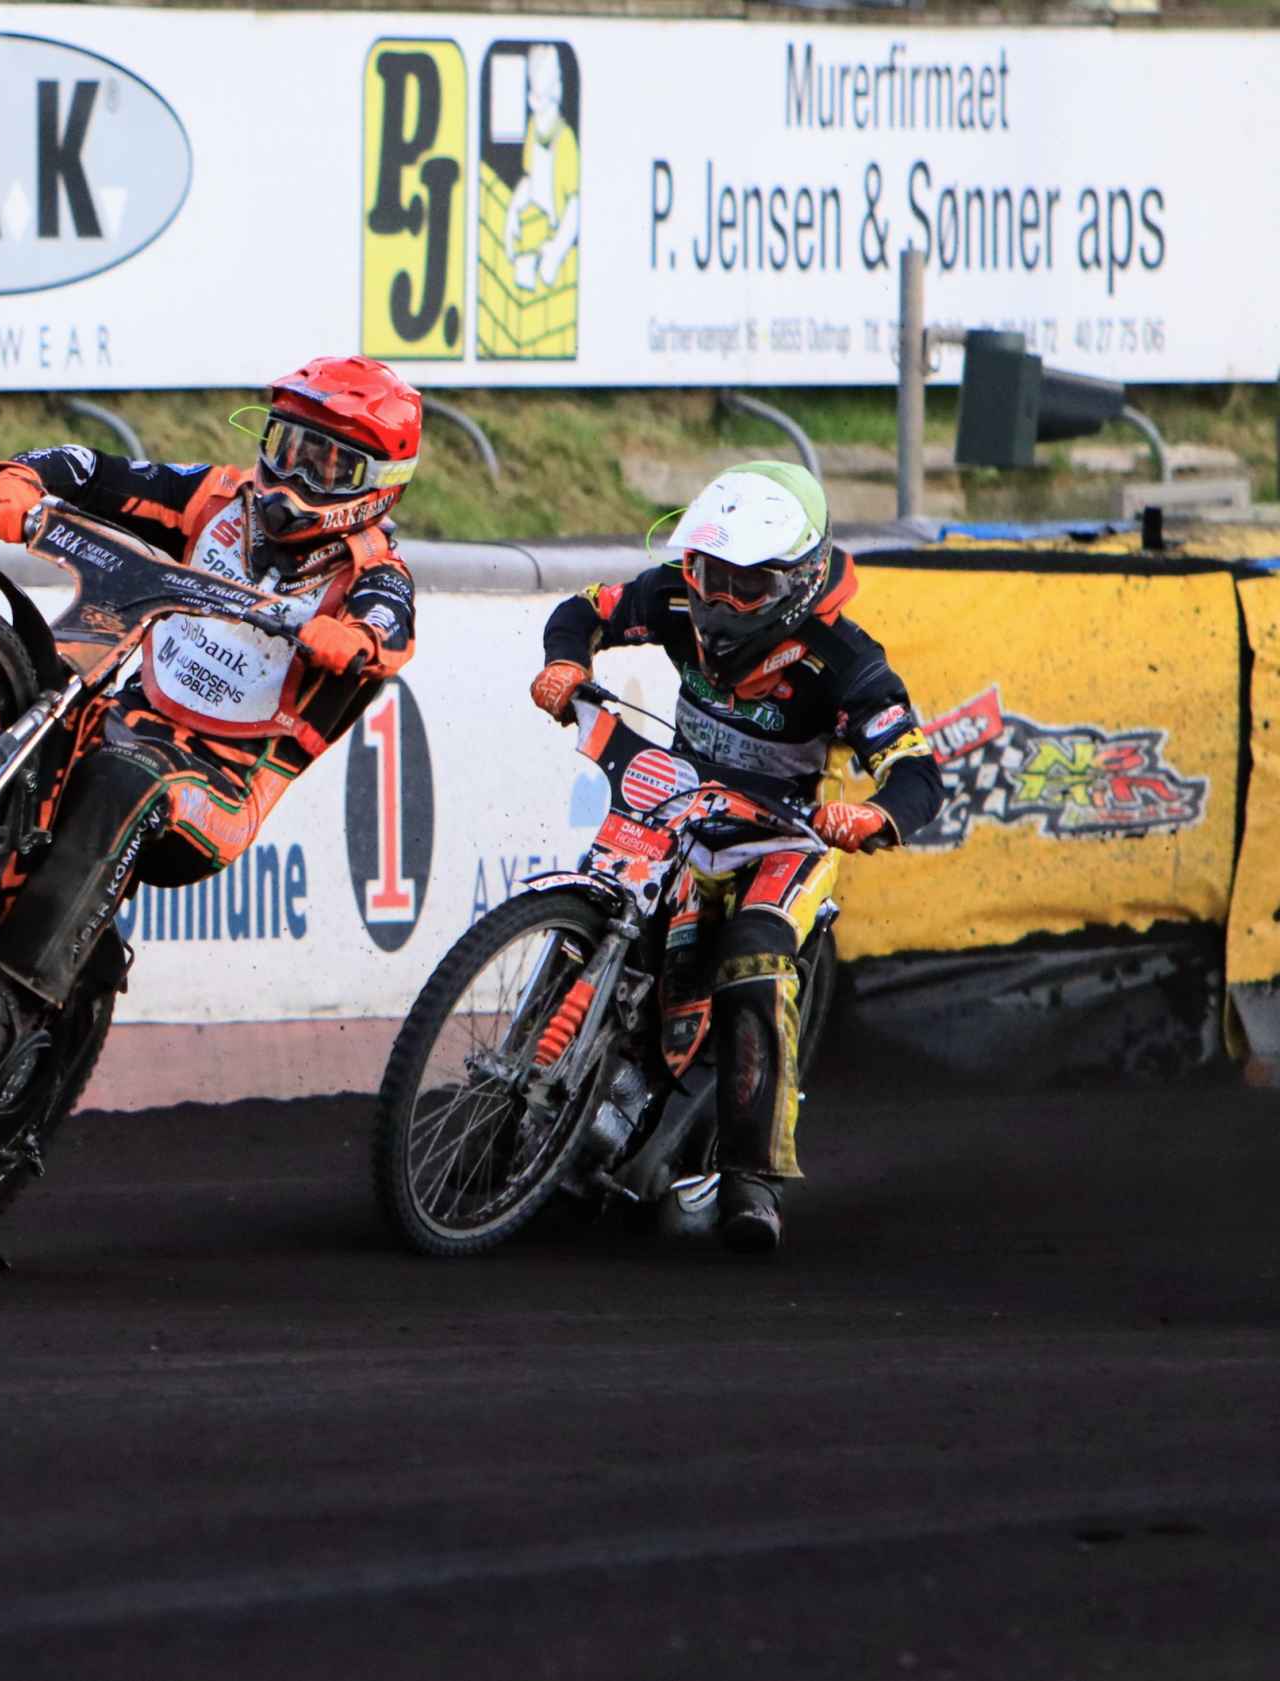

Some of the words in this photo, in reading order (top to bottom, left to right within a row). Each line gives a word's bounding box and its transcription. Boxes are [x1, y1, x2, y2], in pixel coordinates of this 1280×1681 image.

[785, 42, 1009, 130] Murerfirmaet
[651, 160, 676, 272] P.
[693, 160, 842, 272] Jensen
[860, 161, 889, 272] &
[907, 160, 1061, 275] Sønner
[1078, 185, 1166, 296] aps
[361, 684, 416, 924] 1
